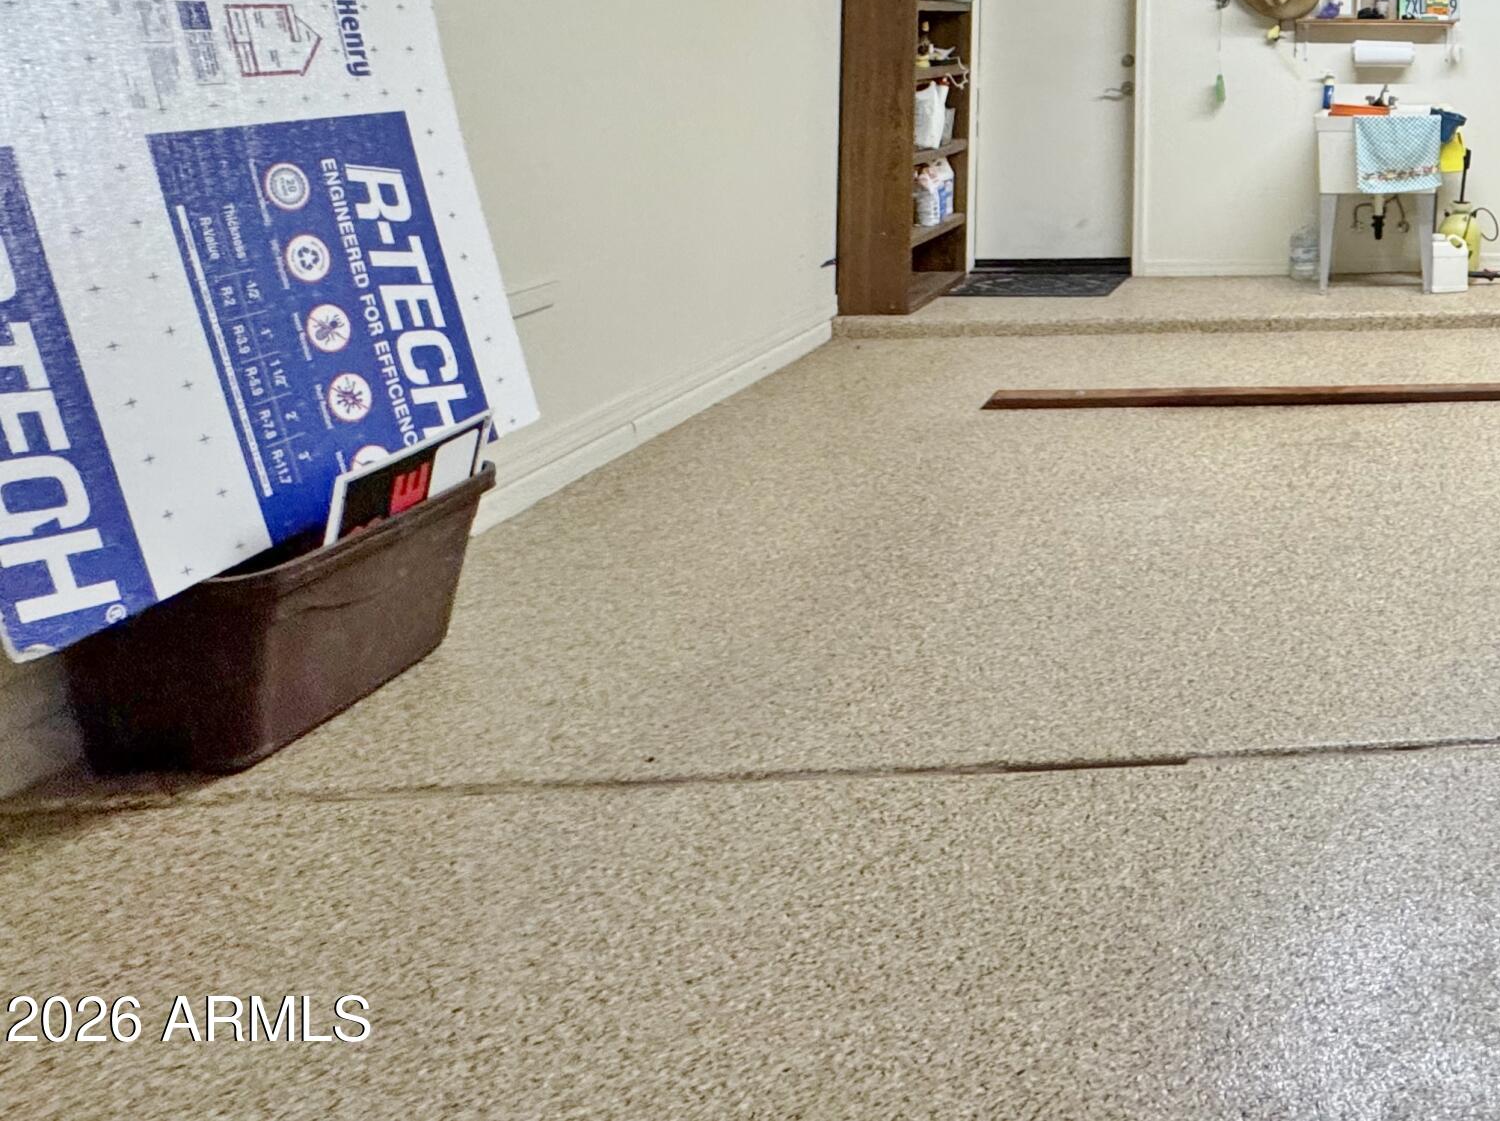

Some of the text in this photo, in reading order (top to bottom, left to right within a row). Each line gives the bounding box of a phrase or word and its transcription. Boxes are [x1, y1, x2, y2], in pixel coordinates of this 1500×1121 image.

[336, 0, 372, 77] Henry
[200, 216, 221, 261] R-Value
[220, 286, 238, 307] R-2
[271, 448, 294, 484] R-11.7
[223, 202, 248, 260] Thickness
[320, 158, 370, 288] ENGINEERED
[359, 293, 384, 336] FOR
[373, 341, 419, 449] EFFICIENC
[345, 164, 468, 442] R-TECH
